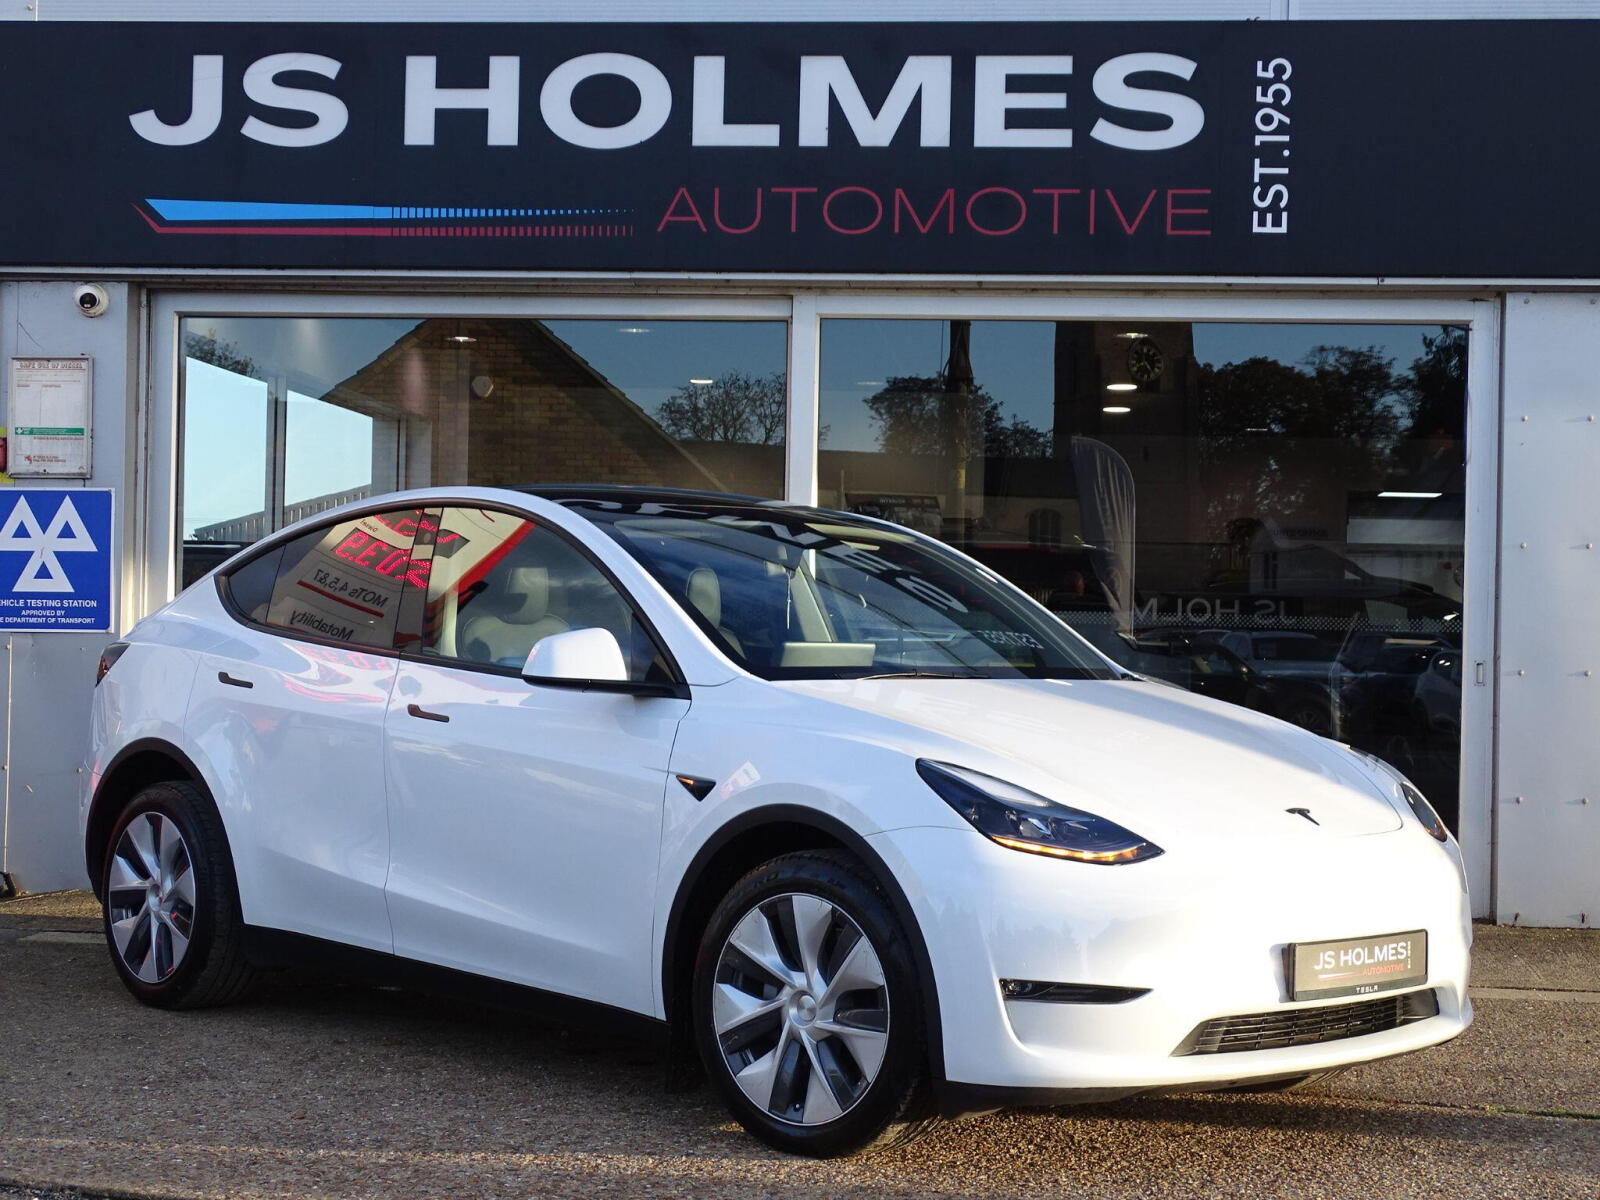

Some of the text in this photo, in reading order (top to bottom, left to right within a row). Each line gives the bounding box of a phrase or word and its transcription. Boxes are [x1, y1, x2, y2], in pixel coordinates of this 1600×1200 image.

[129, 52, 1205, 150] JS HOLMES
[1252, 57, 1293, 235] EST.1955
[657, 186, 1212, 237] AUTOMOTIVE
[27, 599, 61, 607] TESTING
[63, 599, 97, 608] STATION
[1314, 950, 1336, 970] JS
[1340, 941, 1407, 967] HOLMES
[1363, 963, 1405, 977] AUTOMOTIVE
[1355, 984, 1379, 993] TESLA
